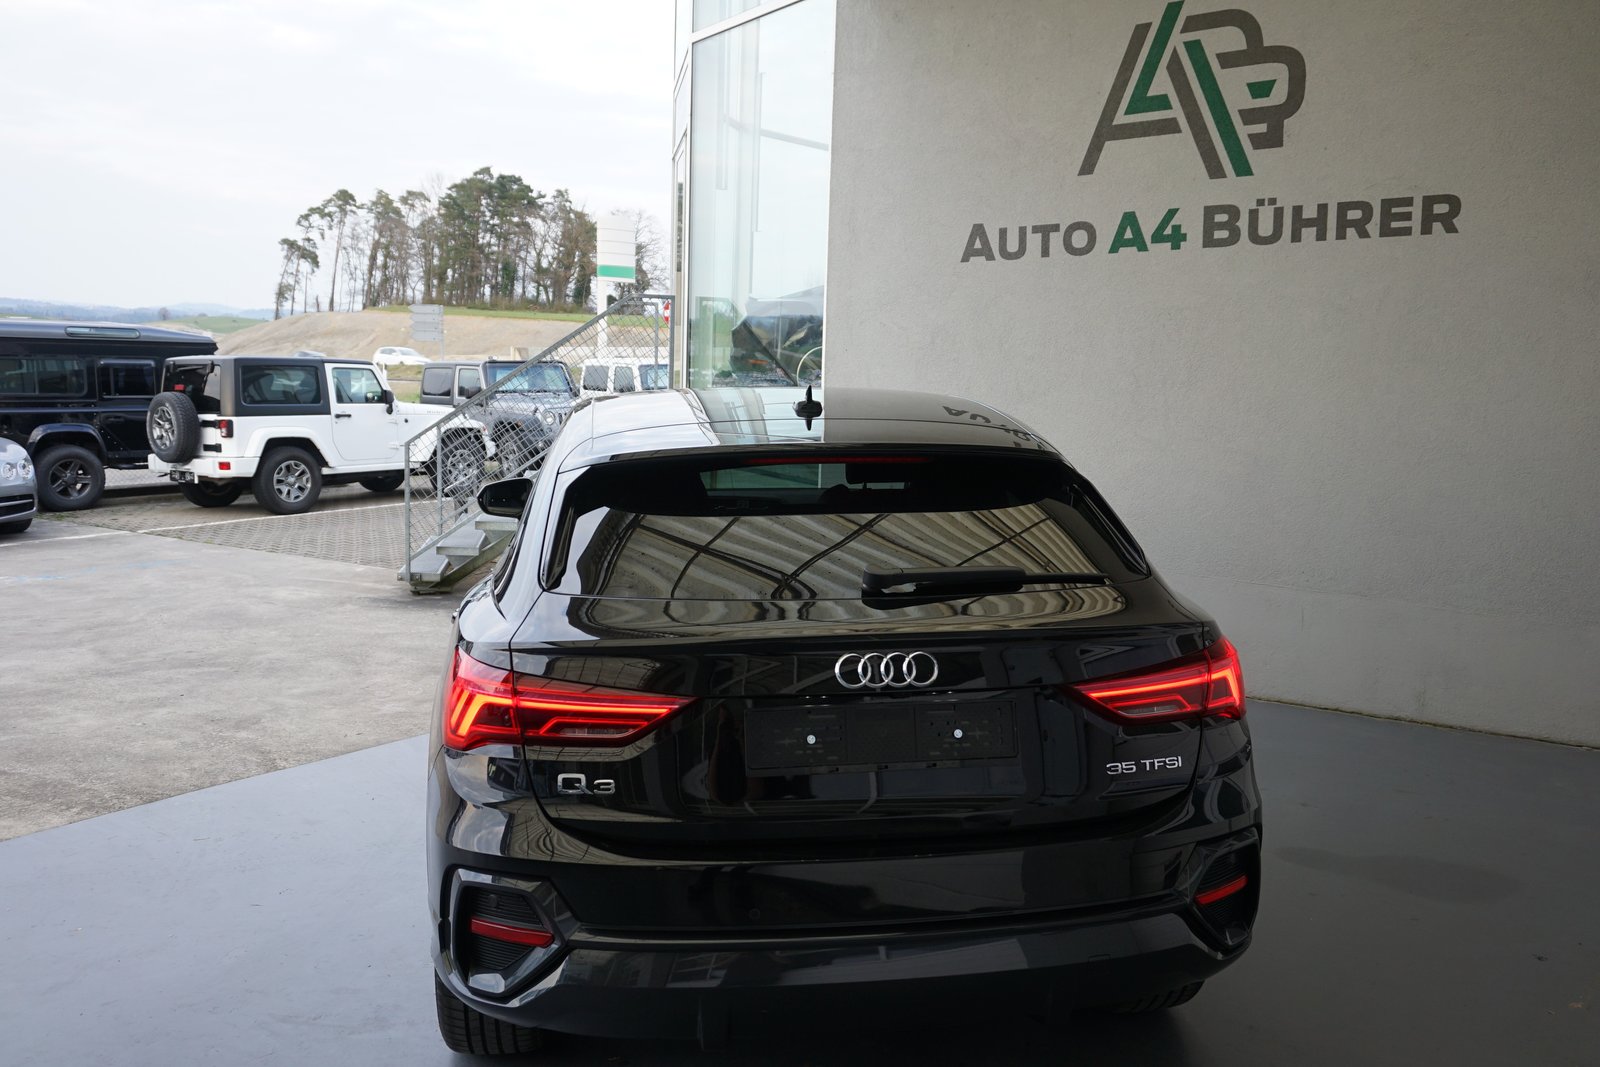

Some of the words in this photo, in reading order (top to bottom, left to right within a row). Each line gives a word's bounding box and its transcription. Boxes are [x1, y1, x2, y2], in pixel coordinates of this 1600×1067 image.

[960, 220, 1098, 264] AUTO
[1107, 207, 1188, 255] A4
[1201, 193, 1463, 250] BÜHRER
[1105, 761, 1137, 776] 35
[1140, 755, 1183, 772] TFSI
[556, 772, 616, 796] Q3
